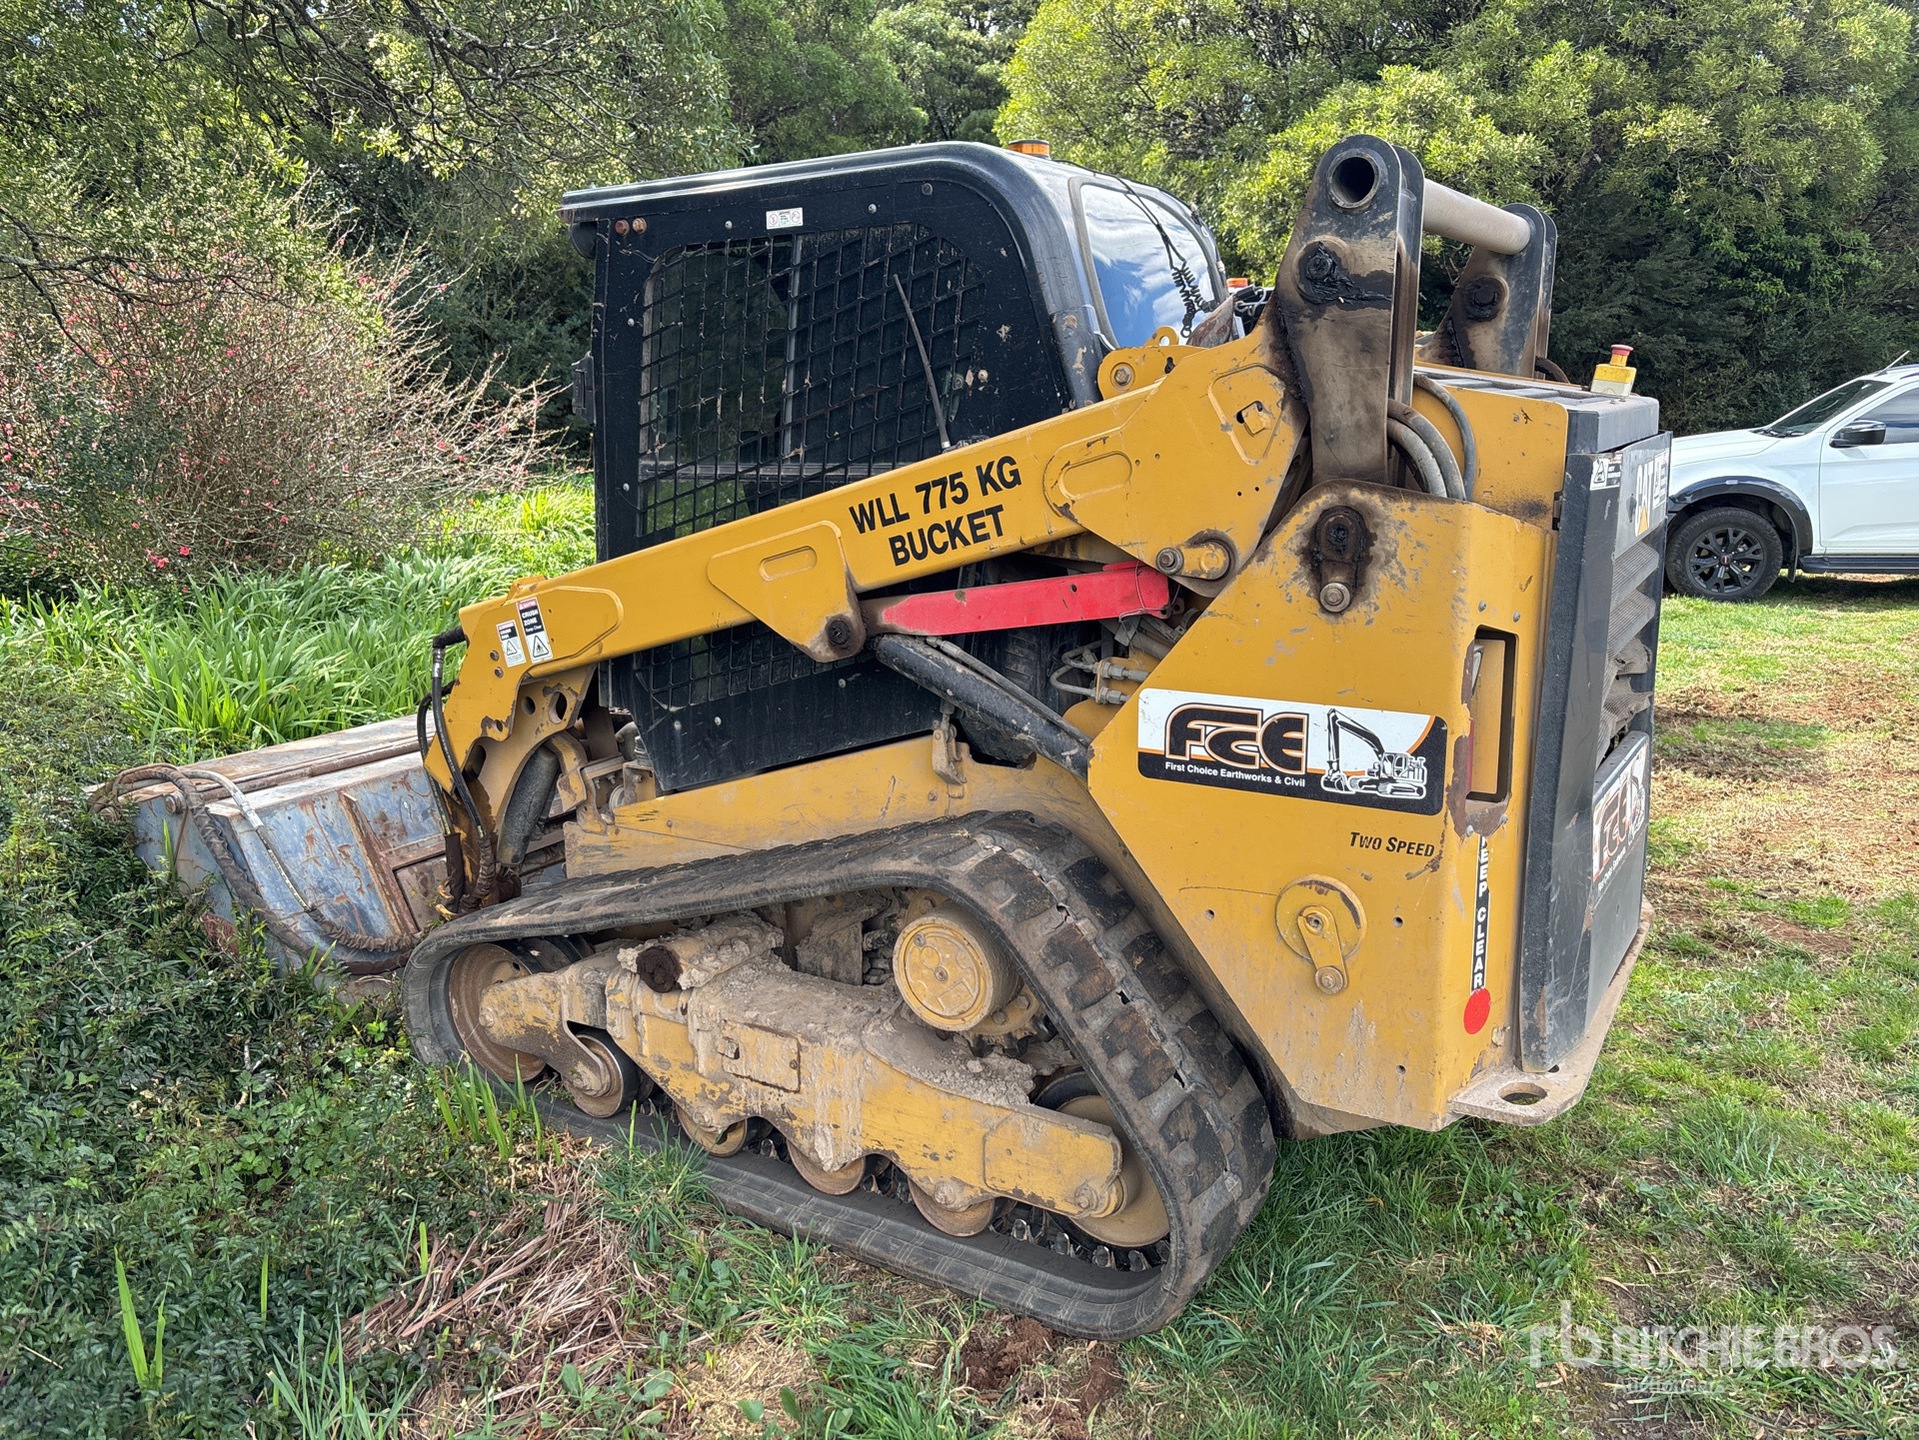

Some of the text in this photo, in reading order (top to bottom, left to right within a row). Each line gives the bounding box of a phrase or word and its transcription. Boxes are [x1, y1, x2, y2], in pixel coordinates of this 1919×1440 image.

[848, 456, 1022, 534] WLL 775 KG
[1635, 461, 1654, 537] CAT
[888, 504, 1004, 566] BUCKET
[1164, 702, 1310, 775] FCE
[1165, 762, 1305, 787] First Choice Earthworks & Civil
[1474, 906, 1487, 989] CLEAR
